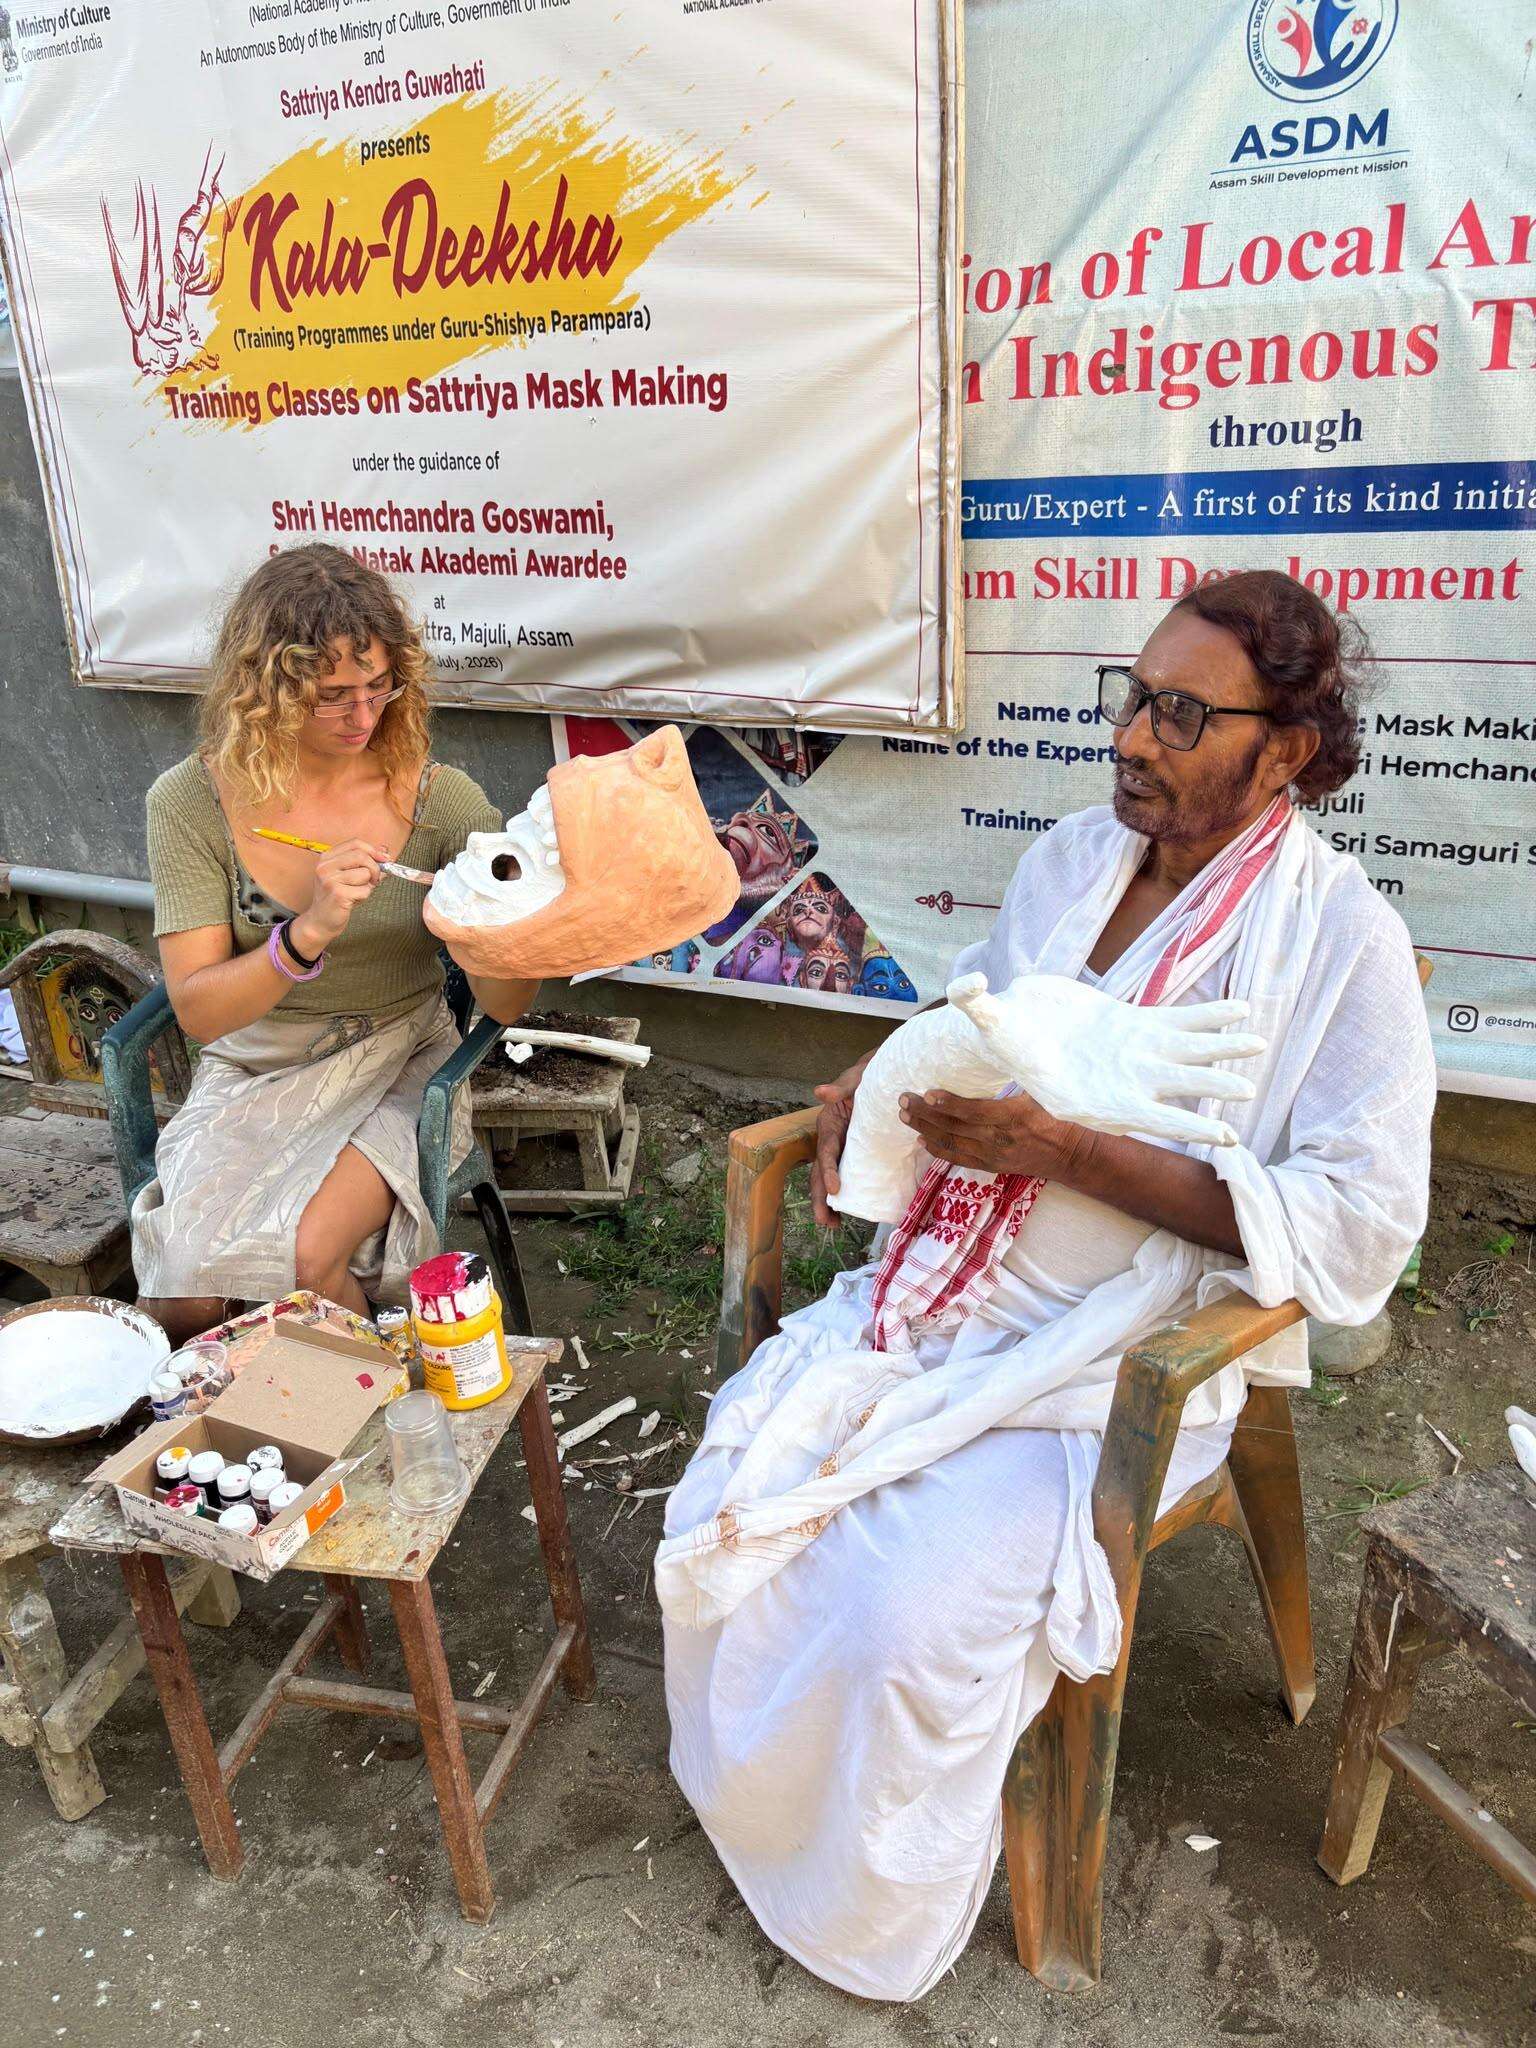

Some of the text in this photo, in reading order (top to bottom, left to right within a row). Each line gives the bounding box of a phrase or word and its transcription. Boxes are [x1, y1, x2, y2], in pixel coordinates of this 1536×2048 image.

[16, 5, 111, 39] Ministry of Culture
[249, 1, 292, 28] (National
[683, 1, 719, 14] NATIONAL
[21, 33, 103, 64] Government of India
[200, 50, 213, 68] An
[215, 38, 276, 64] Autonomous
[278, 33, 305, 53] Body
[308, 28, 319, 49] of
[320, 25, 338, 46] the
[340, 20, 382, 43] Ministry
[386, 14, 397, 34] of
[399, 9, 445, 33] Culture,
[447, 0, 522, 24] Government
[1252, 32, 1263, 61] SKILL
[364, 48, 385, 66] and
[280, 60, 486, 120] Sattriya Kendra Guwahati
[1257, 60, 1283, 88] ASSAM
[360, 132, 431, 165] presents
[1229, 108, 1390, 163] ASDM
[1208, 158, 1408, 191] Assam Skill Development Mission
[243, 173, 623, 313] Kala-Deeksha
[1080, 227, 1164, 301] of
[1173, 202, 1407, 293] Local
[233, 305, 652, 353] (Training Programmes under Guru-Shishya Parampara)
[1007, 322, 1440, 412] Indigenous
[1471, 296, 1536, 372] T
[165, 363, 729, 426] Training Classes on Sattriya Mask Making
[1208, 408, 1364, 453] through
[352, 450, 501, 475] under the guidance of
[961, 493, 1127, 527] Guru/Expert
[1136, 505, 1149, 513] -
[1157, 490, 1183, 518] A
[1193, 488, 1256, 517] first
[1267, 486, 1307, 515] of
[1313, 484, 1352, 514] its
[1364, 481, 1440, 513] kind
[271, 500, 615, 542] Shri Hemchandra Goswami,
[352, 546, 415, 574] Natak
[421, 547, 519, 576] Akademi
[525, 549, 628, 580] Awardee
[1033, 556, 1139, 600] Skill
[1157, 555, 1525, 613] Dlopment
[434, 595, 446, 610] at
[421, 621, 575, 649] ttra, Majuli, Assam
[465, 656, 504, 672] 2026)
[997, 701, 1071, 723] Name
[1375, 714, 1456, 737] Mask
[881, 736, 951, 755] Name
[956, 737, 982, 756] of
[987, 738, 1029, 758] the
[1036, 740, 1117, 766] Expert
[1331, 832, 1367, 853] Sri
[1374, 834, 1519, 865] Samaguri
[1485, 1016, 1536, 1030] @asdm
[122, 1490, 148, 1508] Camel
[154, 1513, 197, 1536] WHOLESALE
